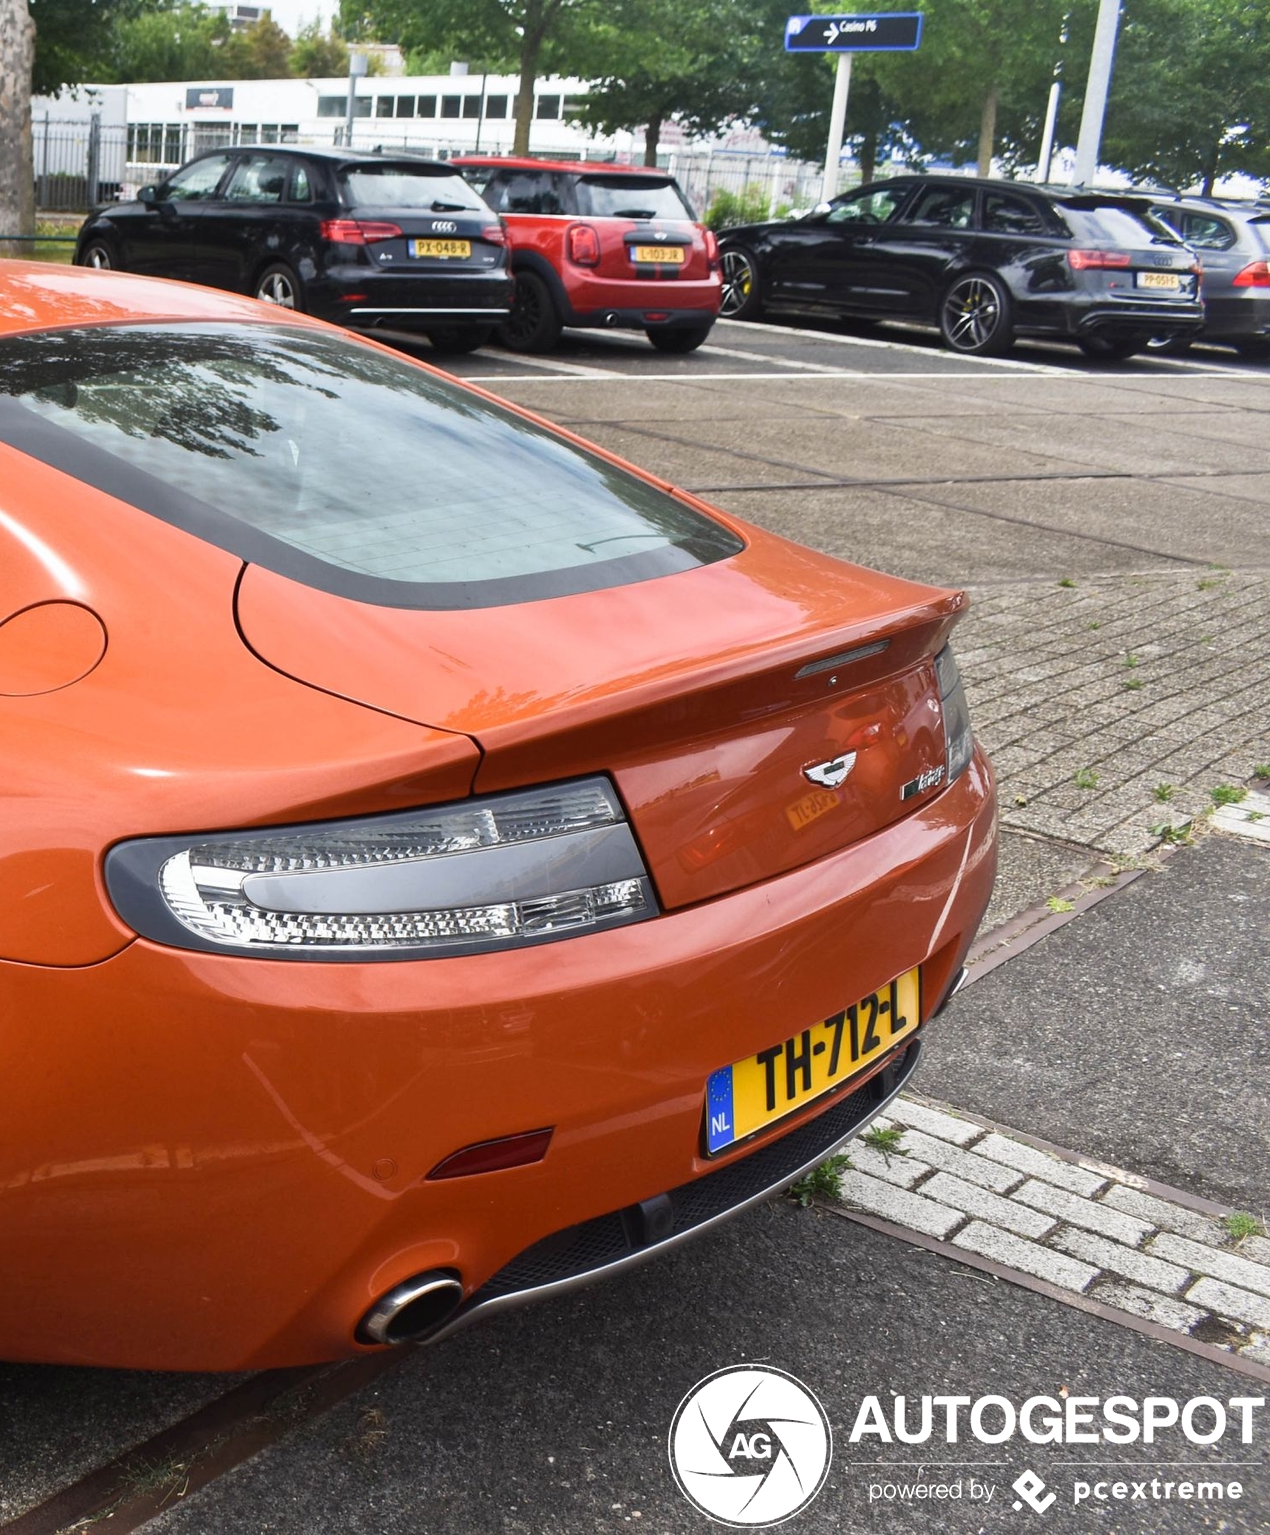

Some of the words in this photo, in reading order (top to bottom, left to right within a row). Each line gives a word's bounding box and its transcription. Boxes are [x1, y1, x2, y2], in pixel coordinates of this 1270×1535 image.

[839, 20, 865, 33] Casino
[418, 241, 467, 254] PX-048-R
[757, 981, 907, 1111] TH-712-L
[711, 1112, 730, 1137] NL
